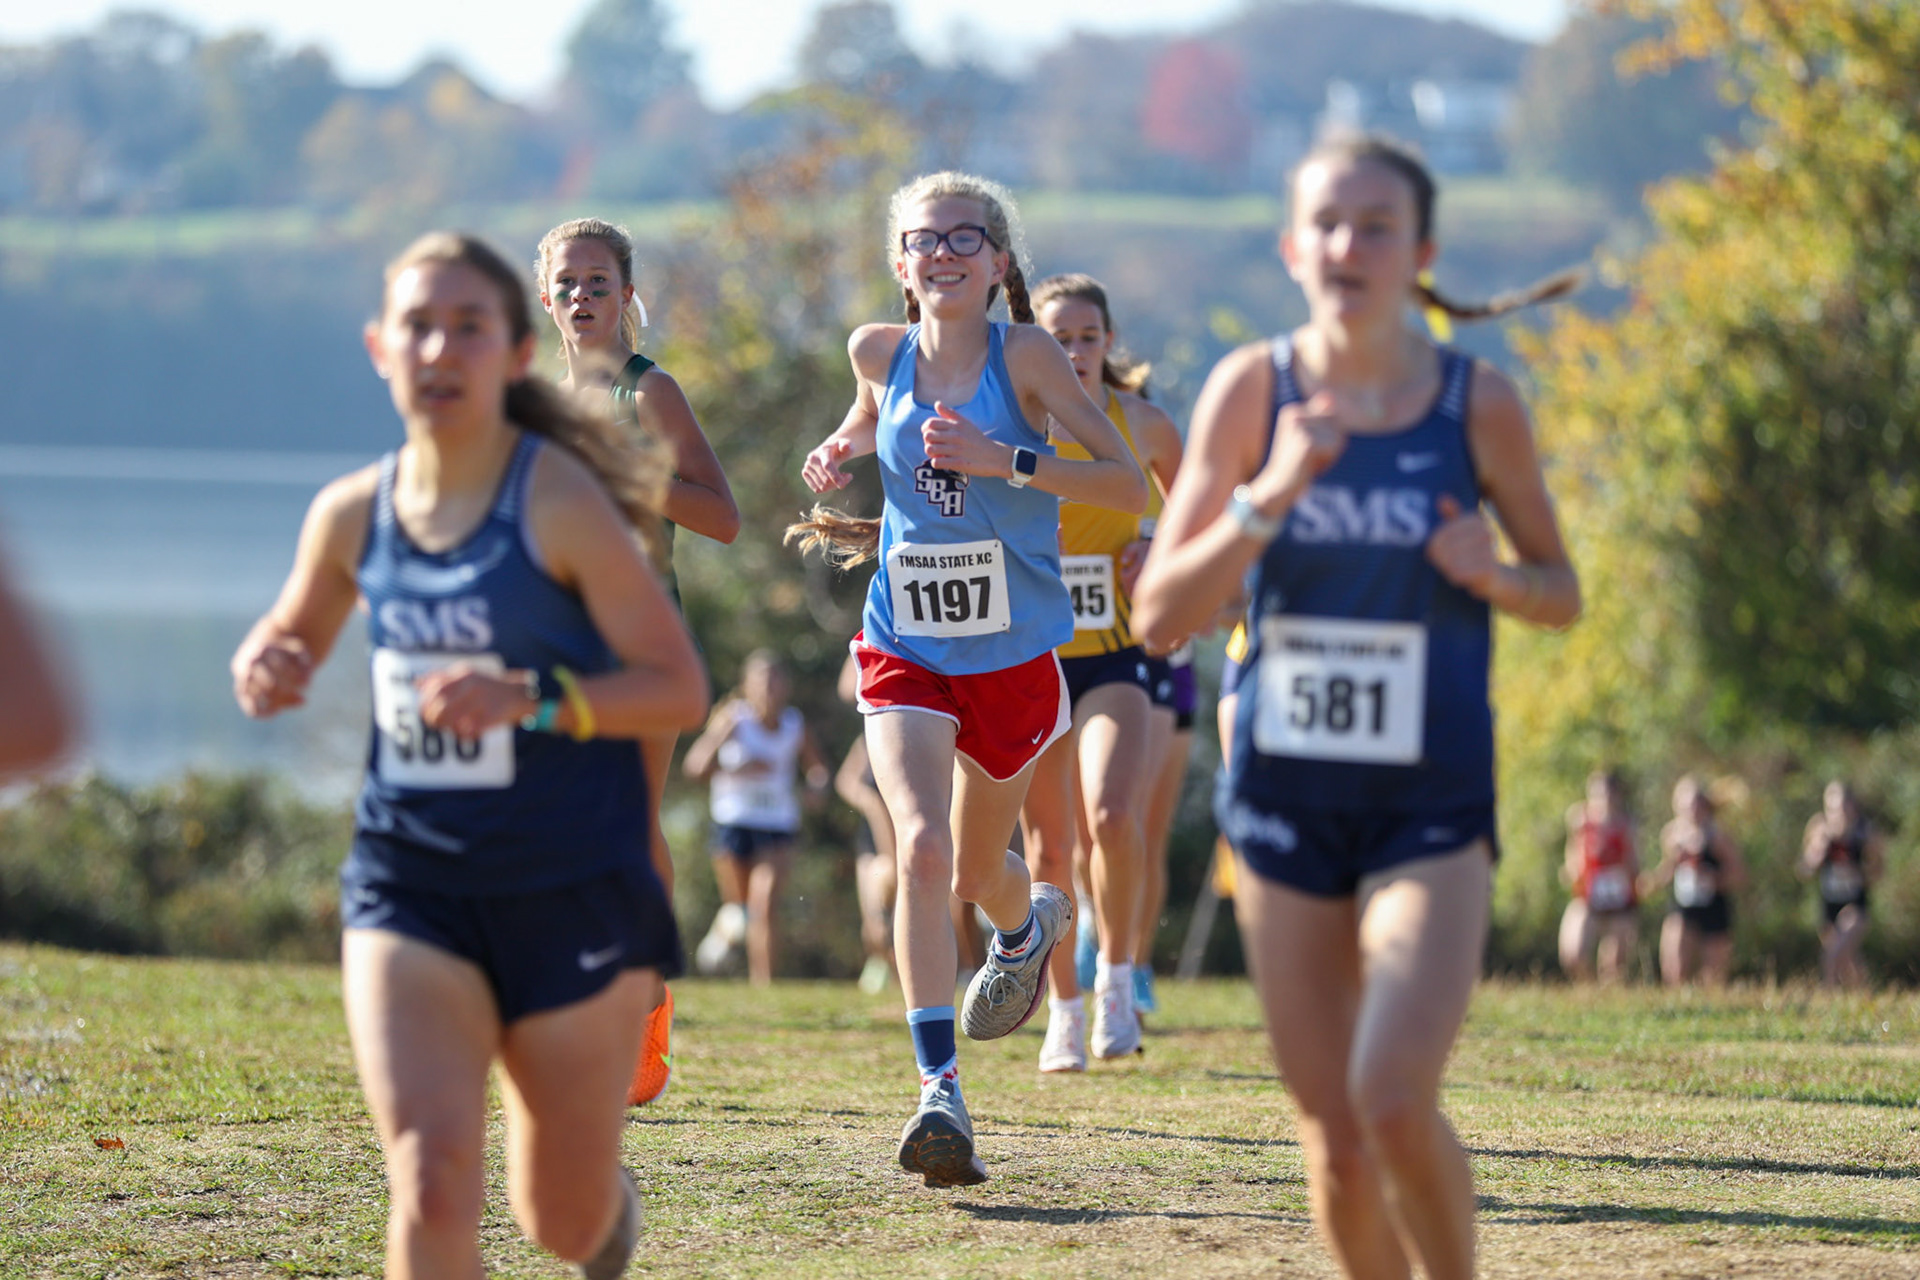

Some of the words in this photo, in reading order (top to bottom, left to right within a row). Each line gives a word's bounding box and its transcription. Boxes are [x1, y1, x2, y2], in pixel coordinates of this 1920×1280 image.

[915, 468, 963, 515] SBA
[1291, 485, 1428, 546] SMS
[898, 555, 938, 569] TMSAA
[939, 554, 974, 569] STATE
[976, 551, 993, 565] XC
[379, 597, 493, 650] SMS
[903, 575, 991, 623] 1197
[1290, 674, 1386, 736] 581
